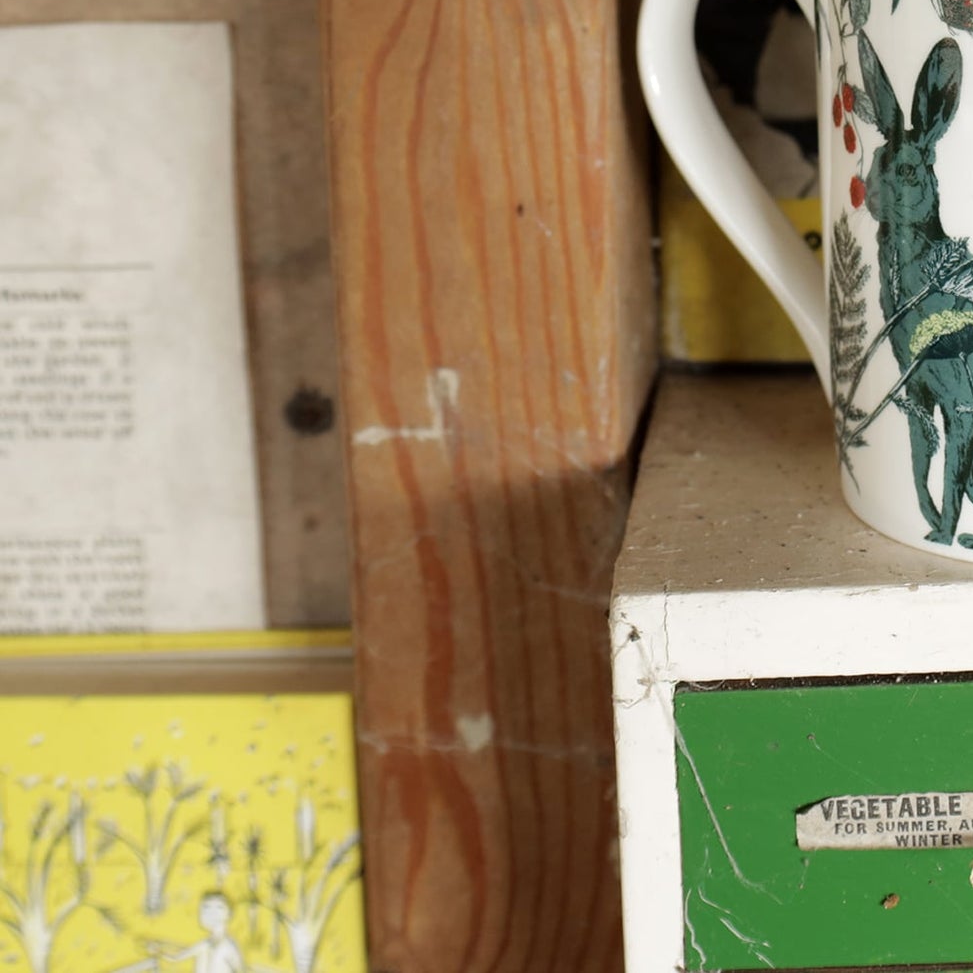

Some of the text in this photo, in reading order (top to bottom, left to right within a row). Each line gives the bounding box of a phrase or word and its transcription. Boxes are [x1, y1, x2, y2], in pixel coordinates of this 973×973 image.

[820, 795, 963, 822] VEGETABLE
[834, 822, 868, 835] FOR
[876, 819, 953, 833] SUMMER,
[895, 833, 963, 848] WINTER
